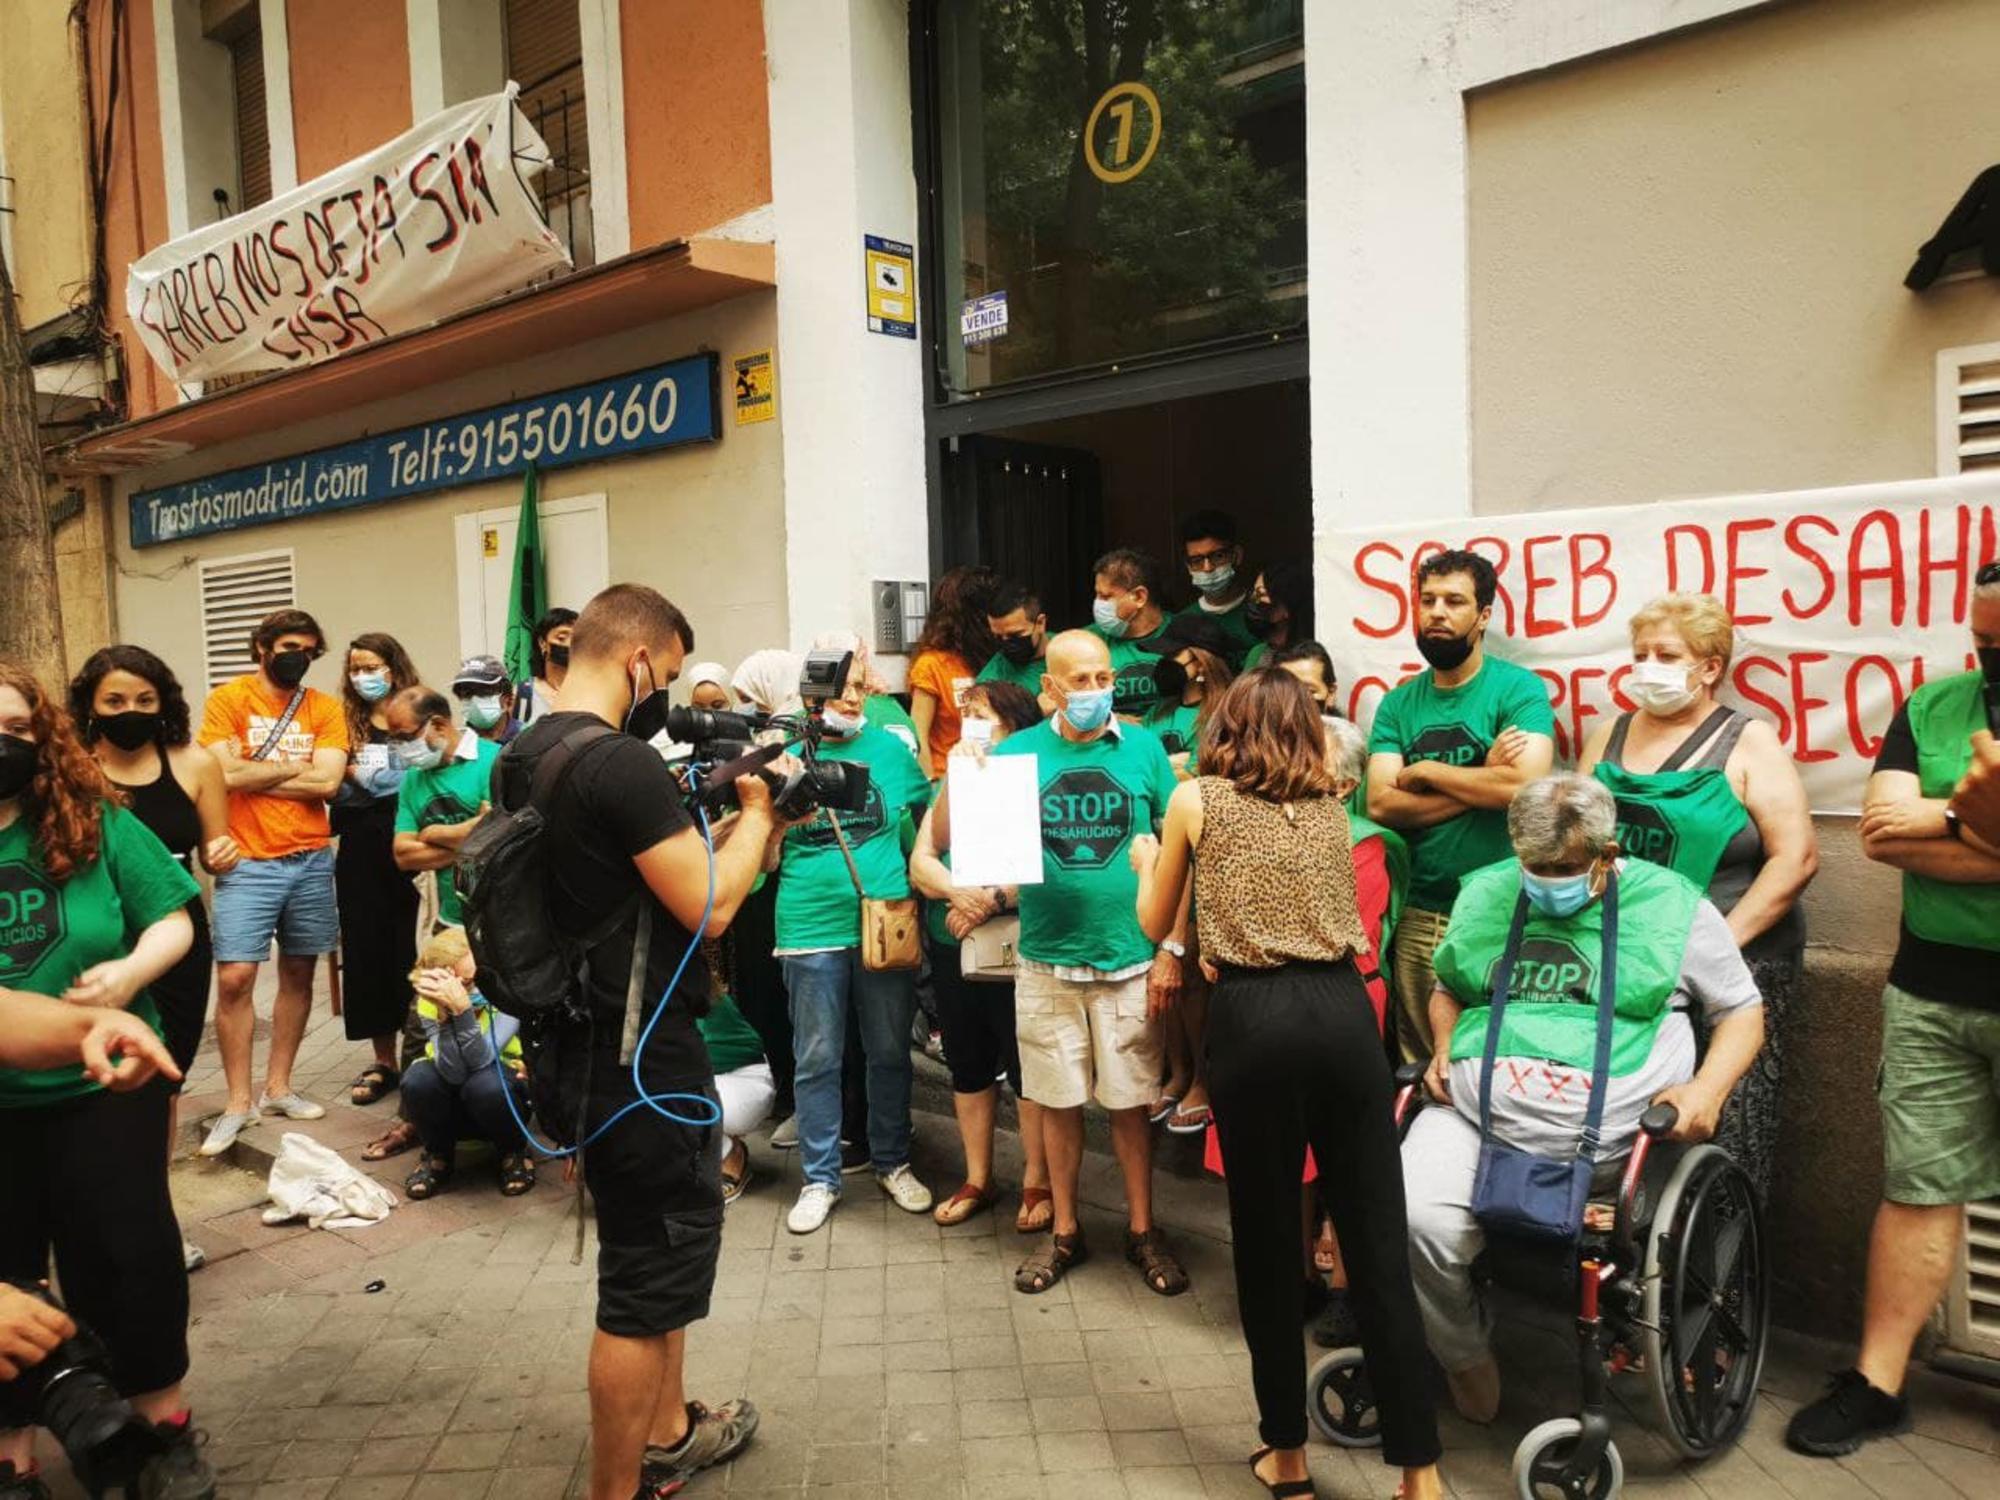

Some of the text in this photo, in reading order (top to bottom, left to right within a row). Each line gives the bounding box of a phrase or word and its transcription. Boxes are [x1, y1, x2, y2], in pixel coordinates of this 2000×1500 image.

[1109, 100, 1134, 165] 1
[140, 252, 247, 367] SAREB
[232, 219, 313, 316] NOS
[262, 286, 388, 361] CASA
[965, 308, 1003, 330] VENDE
[148, 377, 678, 536] Trastosmadrid.com Telf:915501660
[1114, 675, 1157, 698] STO
[1732, 652, 1976, 764] SEQ
[1042, 791, 1123, 823] STOP
[1615, 822, 1665, 857] TOP
